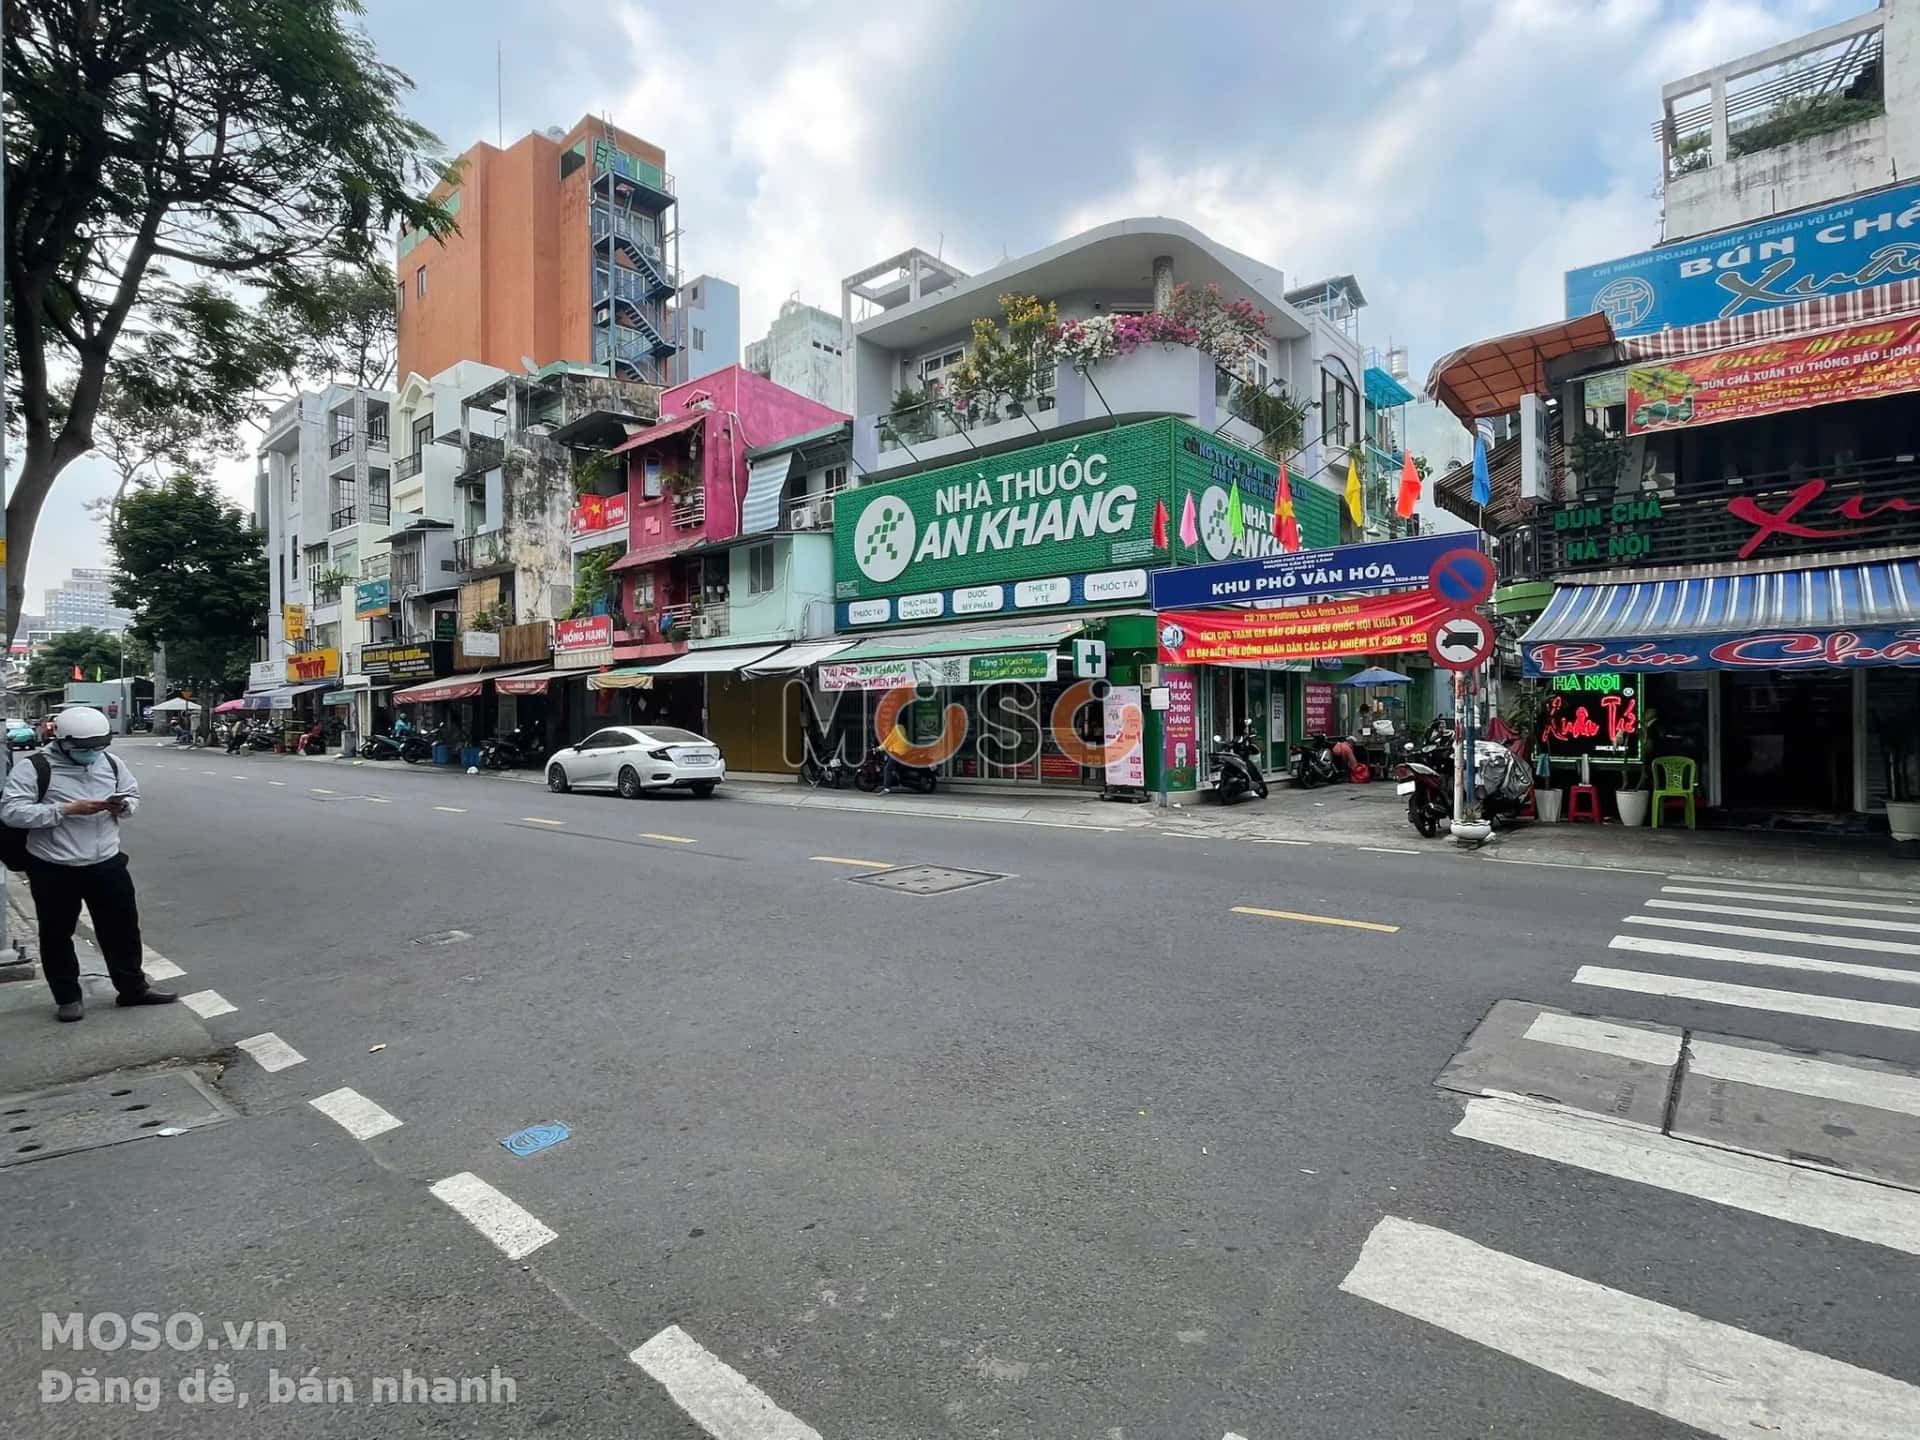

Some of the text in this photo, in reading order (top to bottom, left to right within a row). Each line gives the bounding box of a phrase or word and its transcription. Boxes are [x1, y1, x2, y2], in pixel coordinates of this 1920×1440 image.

[1767, 220, 1803, 236] NHÂN
[1807, 213, 1825, 226] VŨ
[1829, 208, 1854, 221] LAN
[1680, 236, 1795, 279] BÚN
[1702, 379, 1725, 390] BÚN
[1727, 373, 1750, 386] CHẢ
[1754, 366, 1784, 382] XUÂN
[1807, 357, 1849, 371] THÔNG
[1853, 350, 1879, 364] BÁO
[1883, 344, 1912, 360] LỊCH
[1789, 371, 1832, 386] NGÀY
[936, 444, 1107, 516] NHÀ THUỐC
[914, 485, 1137, 562] AN KHANG
[1242, 503, 1267, 531] NHÀ
[1554, 490, 1662, 530] BÚN CHẢ
[1567, 532, 1650, 561] HÀ NỘI
[1212, 579, 1251, 596] KHU
[1255, 571, 1296, 591] PHỐ
[1301, 567, 1343, 586] VĂN
[1349, 562, 1396, 581] HÓA
[1398, 615, 1414, 626] XVI
[562, 628, 607, 644] HỒNG HẠNH
[1304, 640, 1320, 652] CÁC
[1322, 637, 1338, 650] CẤP
[1340, 636, 1367, 649] NHIỆM
[1531, 642, 1698, 673] Bún
